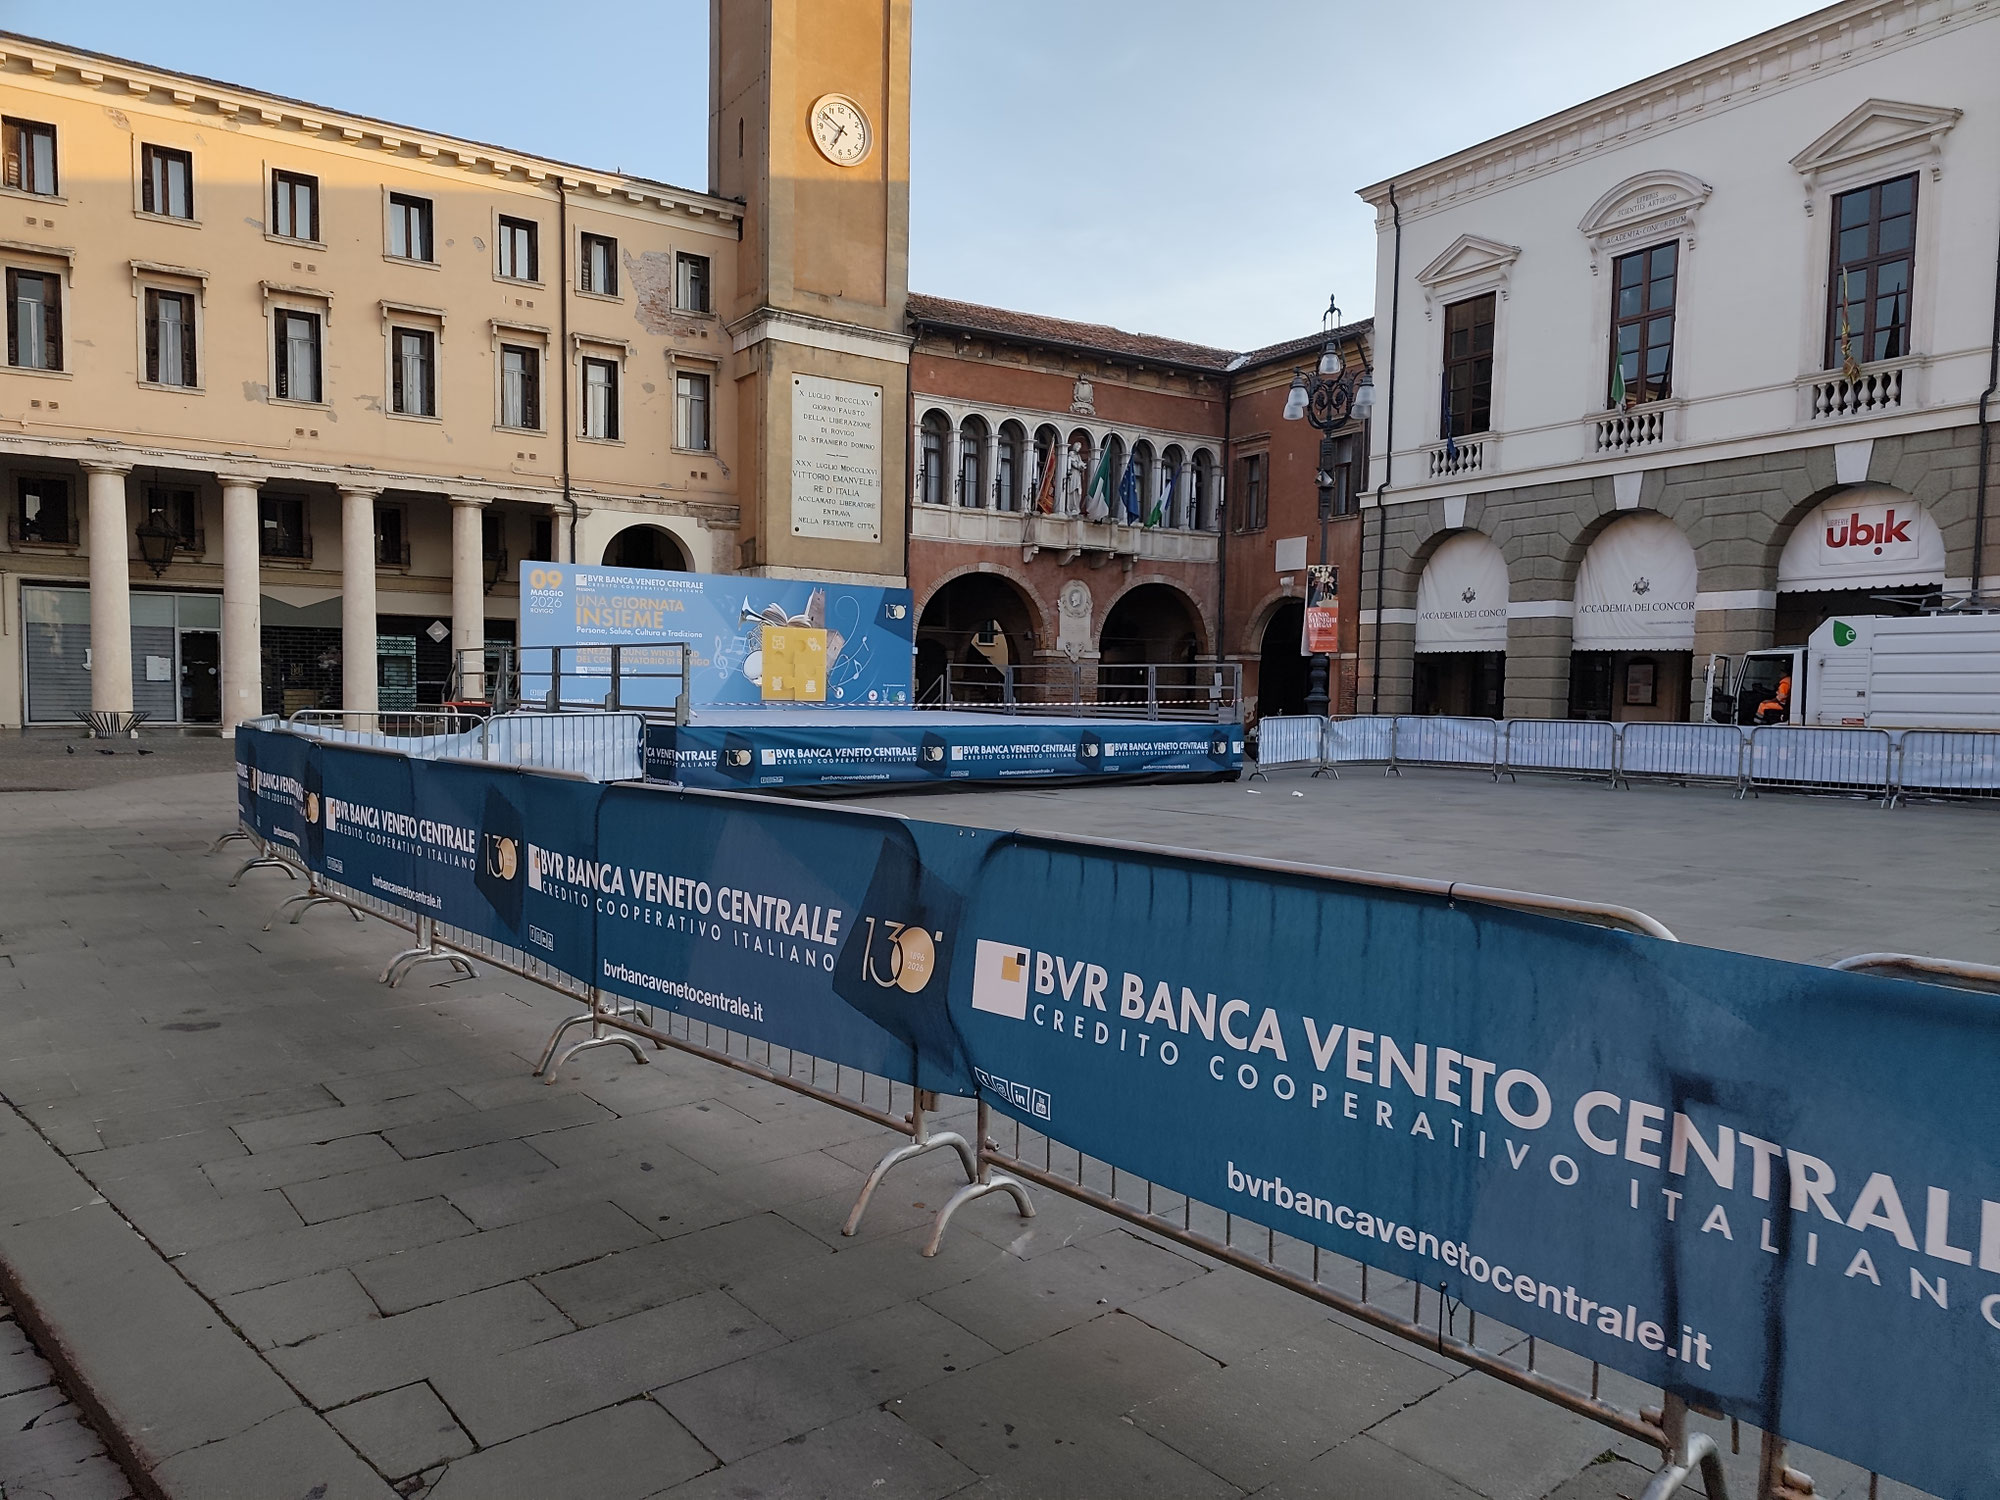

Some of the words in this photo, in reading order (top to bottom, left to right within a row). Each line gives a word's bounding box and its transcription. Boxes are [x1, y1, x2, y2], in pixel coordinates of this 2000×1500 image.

[808, 392, 831, 401] LUGLIO
[812, 404, 836, 413] GIORNO
[838, 408, 866, 416] FAUSTO
[803, 414, 826, 422] DELLA
[828, 417, 872, 429] LIBERAZIONE
[830, 428, 855, 437] ROVIGO
[810, 437, 848, 447] STRANIERO
[850, 442, 875, 451] DOMINIO
[796, 460, 812, 468] XXX
[816, 462, 838, 471] LUGLIO
[792, 470, 830, 482] VITTORIO
[814, 485, 824, 494] RE
[836, 488, 860, 497] ITALIA
[798, 496, 836, 505] ACCLAMATO
[839, 499, 876, 510] LIBERATORE
[822, 509, 851, 518] ENTRAVA
[798, 517, 819, 525] NELLA
[822, 519, 854, 528] FESTANTE
[1826, 510, 1912, 555] ubik
[530, 569, 563, 590] 09
[588, 574, 604, 583] BVR
[605, 576, 634, 585] BANCA
[635, 578, 666, 587] VENETO
[667, 580, 704, 590] CENTRALE
[530, 589, 564, 597] MAGGIO
[621, 584, 668, 592] COOPERATIVO
[531, 596, 562, 608] 2026
[576, 595, 611, 608] UNA
[611, 596, 684, 612] GIORNATA
[1579, 603, 1632, 614] ACCADEMIA
[1634, 603, 1650, 612] DEI
[1652, 602, 1695, 612] CONCOR
[576, 607, 664, 628] INSIEME
[1420, 611, 1464, 620] ACCADEMIA
[576, 626, 608, 635] Persone,
[610, 627, 633, 636] Salute,
[635, 628, 660, 636] Cultura
[668, 630, 702, 638] Tradizione
[621, 649, 648, 657] OUNG
[576, 656, 591, 664] DEL
[594, 656, 664, 666] CONERVATORIO
[676, 658, 710, 666] RVIGO
[777, 749, 794, 758] BVR
[798, 748, 832, 758] BANCA
[835, 748, 872, 758] VENETO
[874, 746, 917, 756] CENTRALE
[964, 745, 980, 754] BVR
[981, 744, 1008, 754] BANCA
[1010, 744, 1040, 754] VENETO
[1041, 744, 1076, 753] CENTRALE
[1115, 742, 1128, 751] BVR
[1129, 742, 1152, 750] BANCA
[1154, 742, 1178, 750] VENETO
[1179, 742, 1208, 750] CENTRALE
[676, 750, 717, 760] NTRALE
[336, 800, 350, 822] BVR
[350, 803, 380, 830] BANCA
[381, 810, 418, 839] VENETO
[419, 820, 476, 854] CENTRALE
[336, 822, 362, 840] CREDITO
[366, 832, 422, 857] COOPERATIVO
[428, 847, 476, 872] ITALIANO
[372, 874, 442, 910] bvrbancavenetocentrale.it
[541, 848, 564, 880] BVR
[567, 856, 626, 896] BANCA
[630, 868, 712, 914] VENETO
[716, 886, 842, 946] CENTRALE
[542, 880, 588, 908] CREDITO
[596, 898, 721, 942] COOPERATIVO
[734, 930, 834, 972] ITALIANO
[908, 961, 924, 972] 2026
[604, 959, 764, 1022] bvrbancavenetocentrale.it
[1034, 952, 1108, 1012] BVR
[1120, 972, 1288, 1062] BANCA
[1303, 1016, 1552, 1130] VENETO
[1033, 1004, 1179, 1066] CREDITO
[1209, 1055, 1579, 1186] COOPERATIVO
[1227, 1160, 1712, 1372] bvrbancavenetocentrale.it
